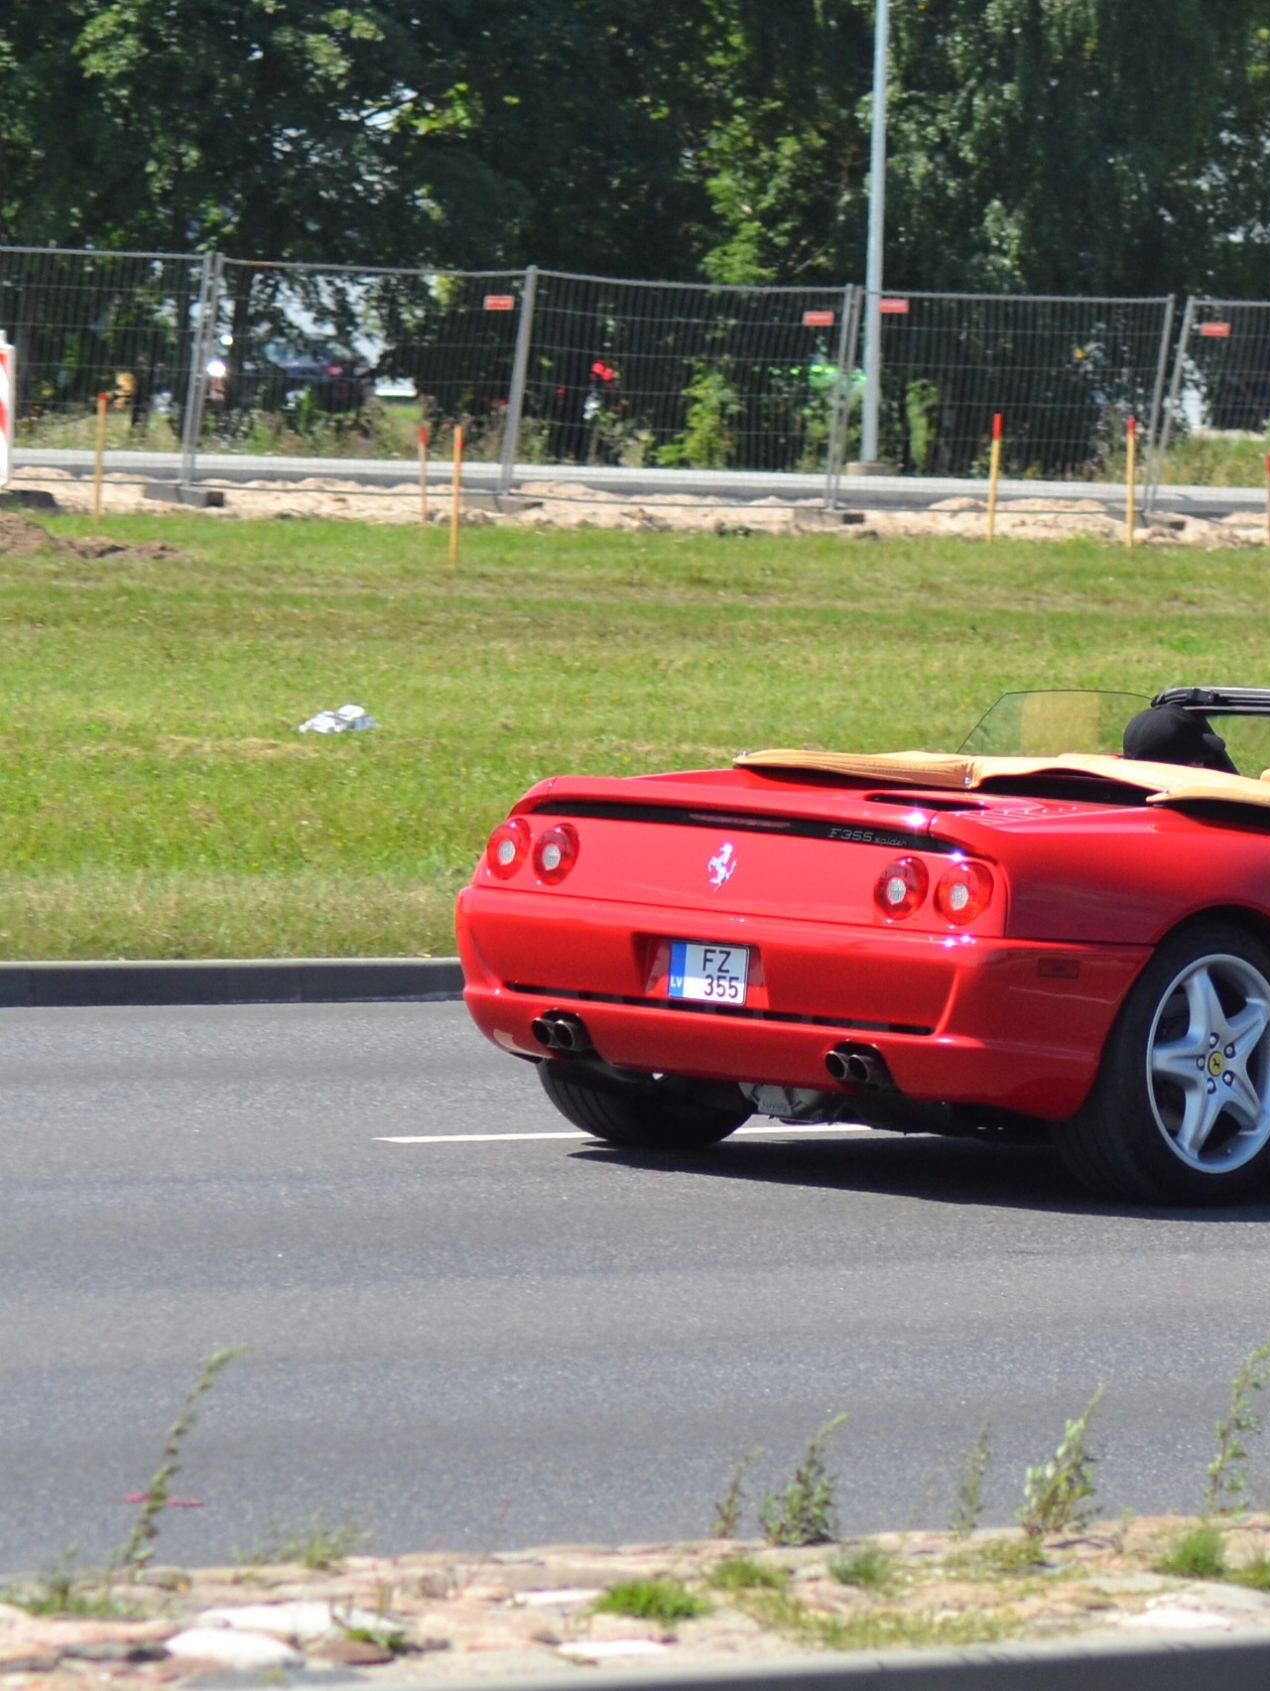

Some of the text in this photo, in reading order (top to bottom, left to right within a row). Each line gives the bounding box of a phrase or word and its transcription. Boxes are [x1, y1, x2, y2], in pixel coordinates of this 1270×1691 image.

[828, 828, 874, 842] F355
[702, 948, 732, 974] FZ
[670, 977, 683, 988] LV
[704, 974, 740, 999] 355
